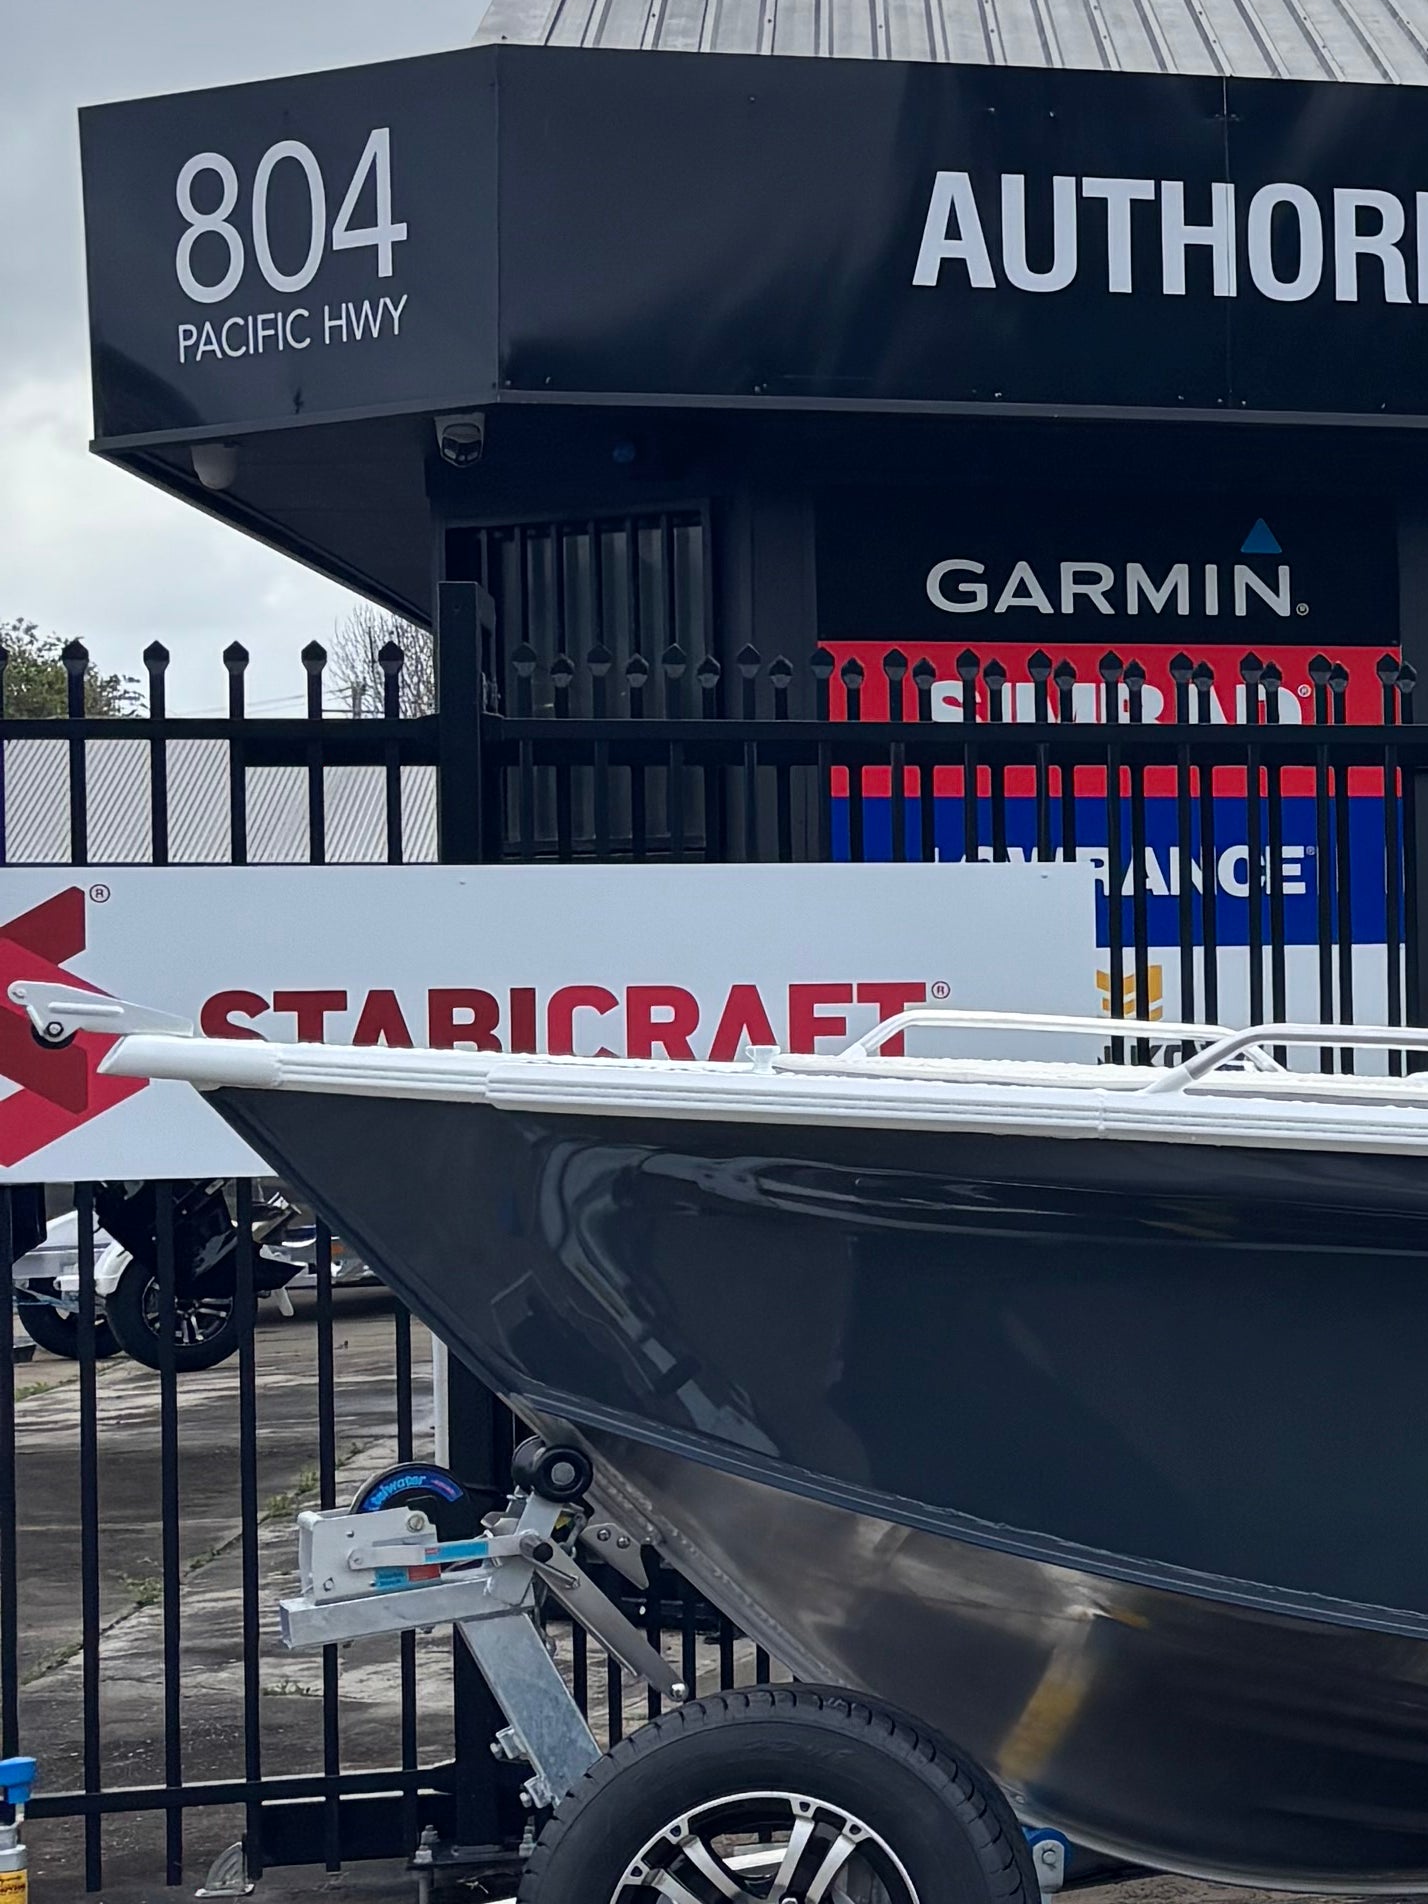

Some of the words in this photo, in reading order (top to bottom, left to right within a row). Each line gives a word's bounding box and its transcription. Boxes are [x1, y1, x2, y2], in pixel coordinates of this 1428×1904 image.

[175, 127, 407, 304] 804
[178, 307, 311, 364] PACIFIC
[323, 295, 408, 346] HWY
[926, 558, 1290, 617] GARMIN
